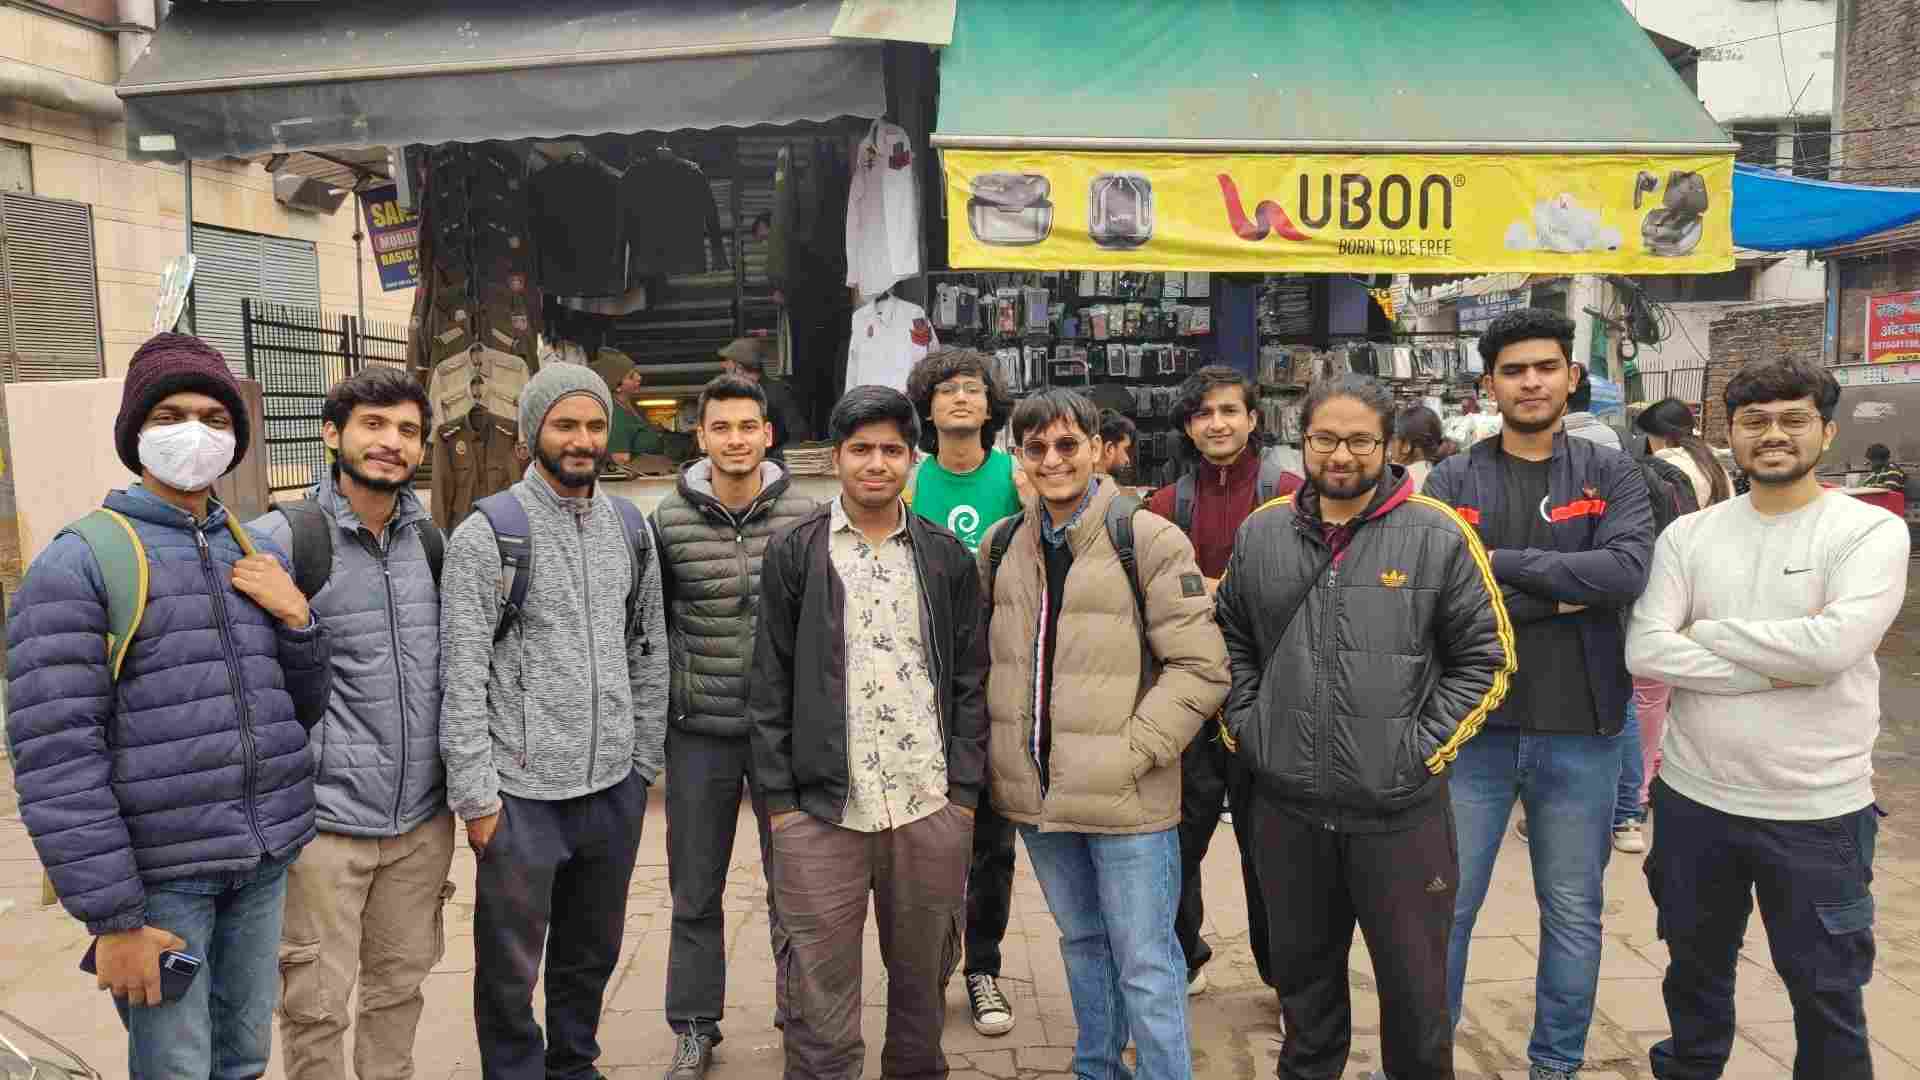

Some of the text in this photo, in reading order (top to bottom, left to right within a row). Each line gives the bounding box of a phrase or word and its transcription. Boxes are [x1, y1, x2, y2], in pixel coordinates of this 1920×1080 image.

[1299, 174, 1452, 230] UBON
[1338, 239, 1451, 256] BORN TO BE FREE
